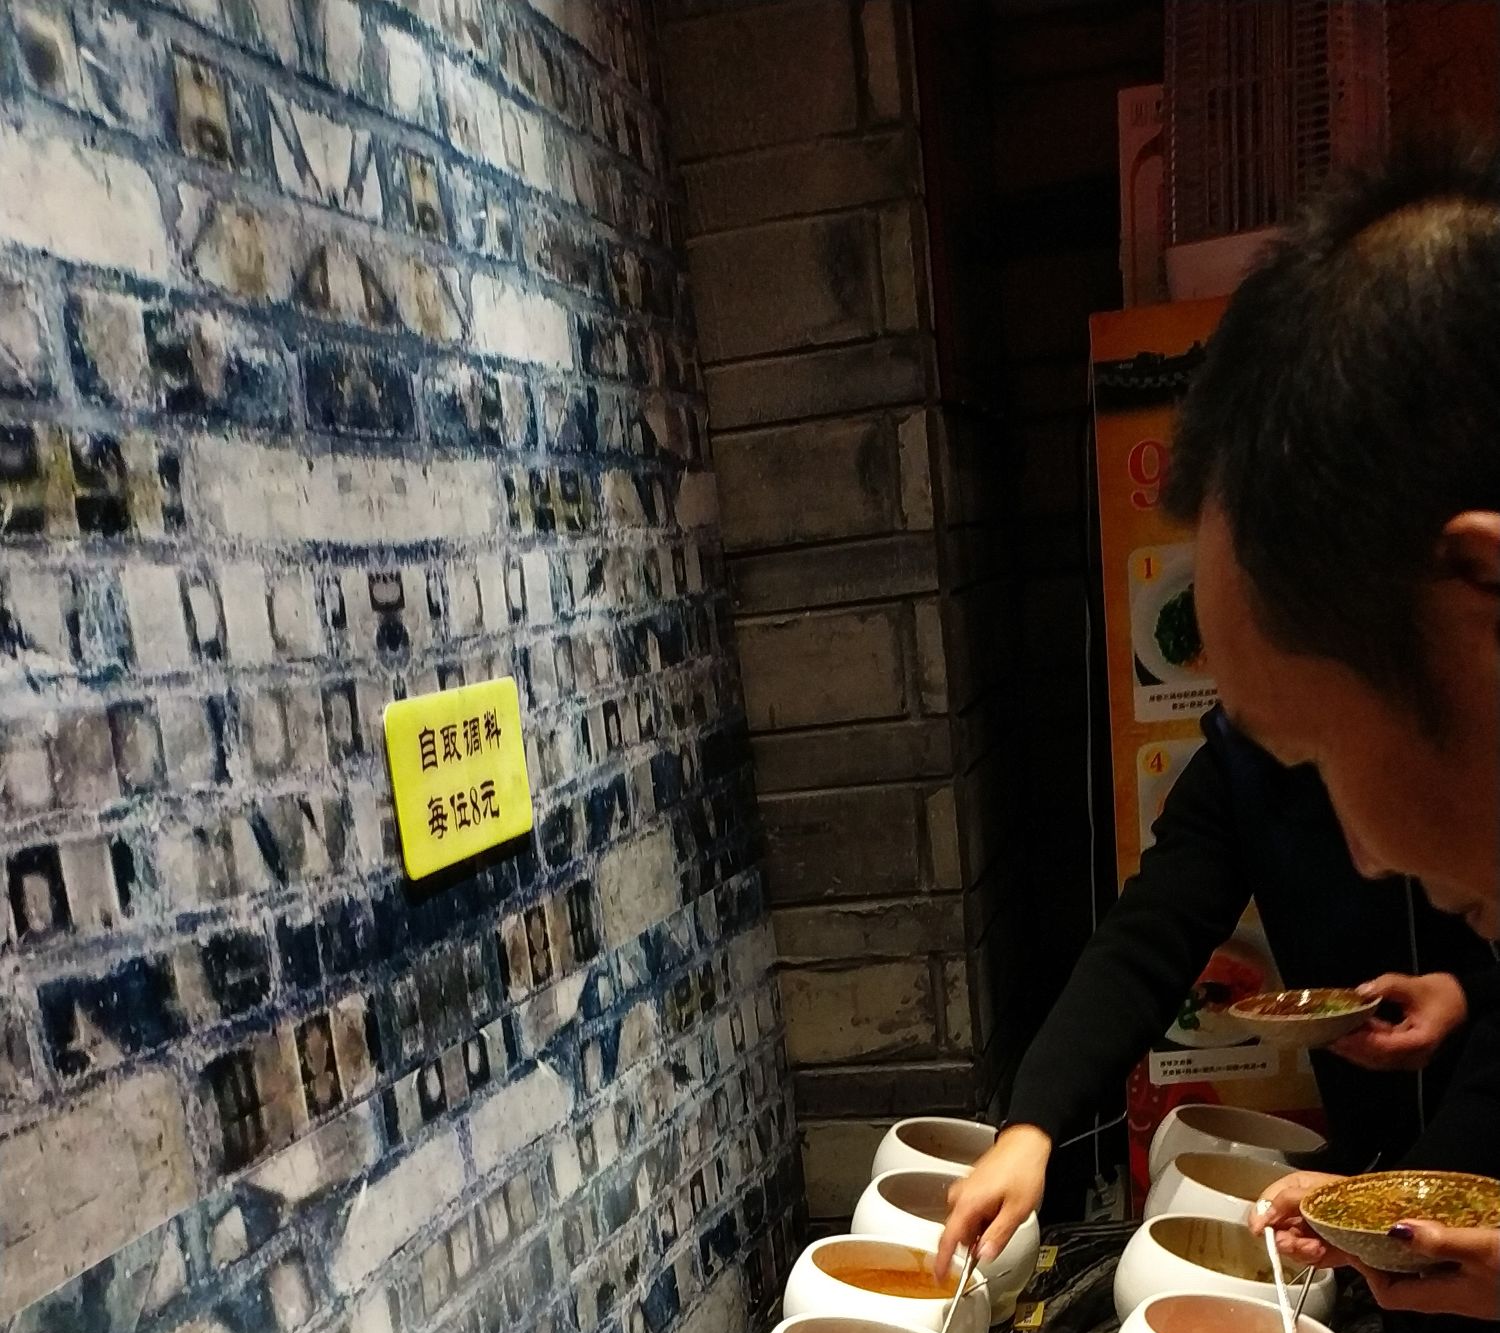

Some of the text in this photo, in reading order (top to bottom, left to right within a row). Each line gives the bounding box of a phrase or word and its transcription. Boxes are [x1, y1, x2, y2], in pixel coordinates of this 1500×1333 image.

[1128, 440, 1172, 511] 9
[418, 708, 502, 773] 自取调料
[1149, 751, 1165, 773] 4
[427, 779, 500, 840] 每位8元
